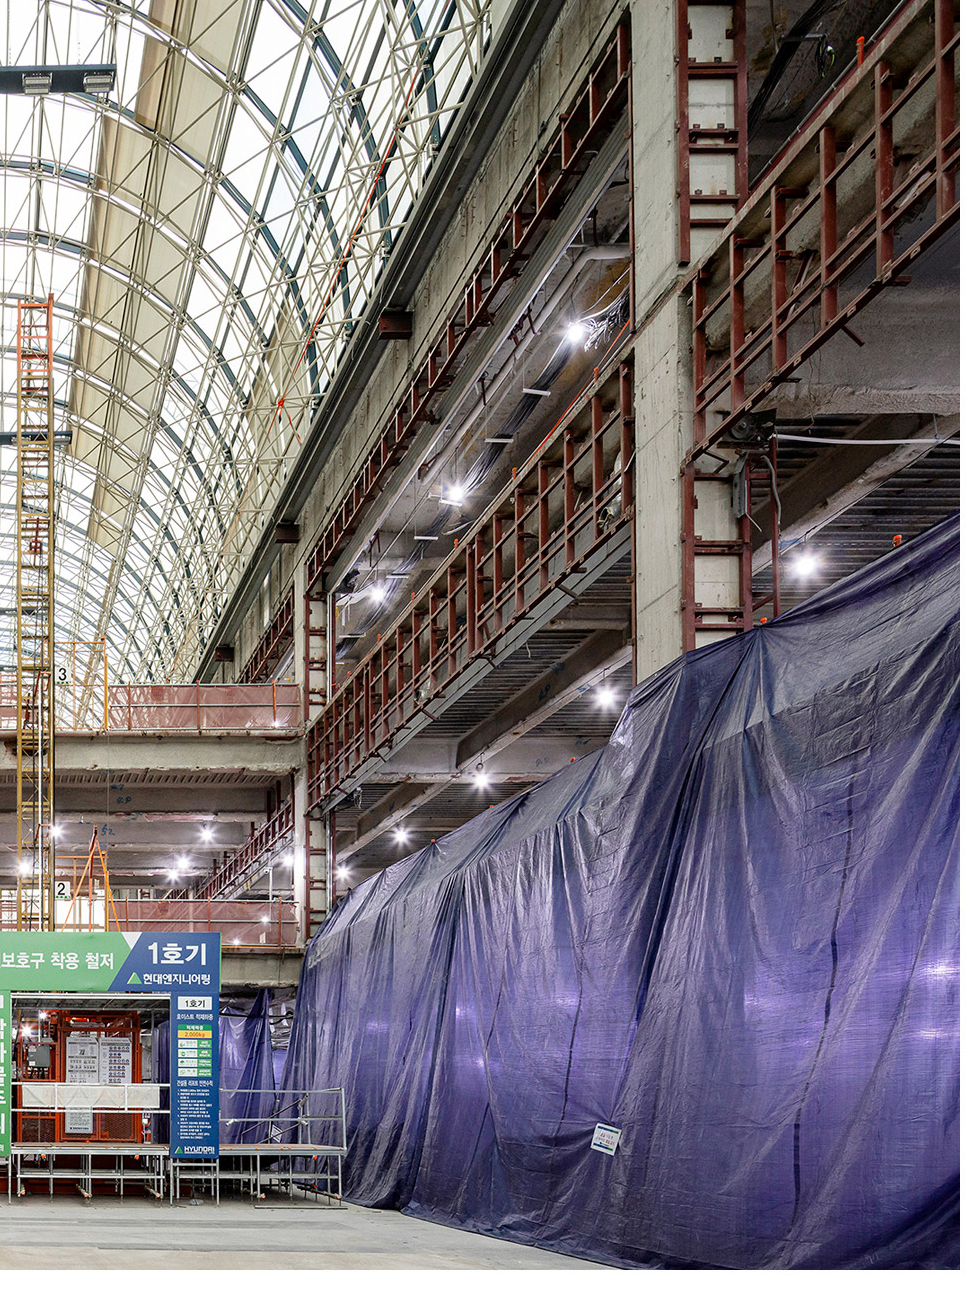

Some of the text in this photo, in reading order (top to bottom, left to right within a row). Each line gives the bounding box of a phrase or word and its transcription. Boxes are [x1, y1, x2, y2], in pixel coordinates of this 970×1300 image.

[58, 667, 67, 681] 3
[57, 882, 66, 896] 2
[147, 941, 207, 966] 1호기
[50, 952, 79, 969] 착용
[85, 952, 114, 970] 철저
[142, 973, 211, 986] 현대엔지니어링
[185, 999, 206, 1008] 1호기
[184, 1146, 215, 1154] HYUNDAI
